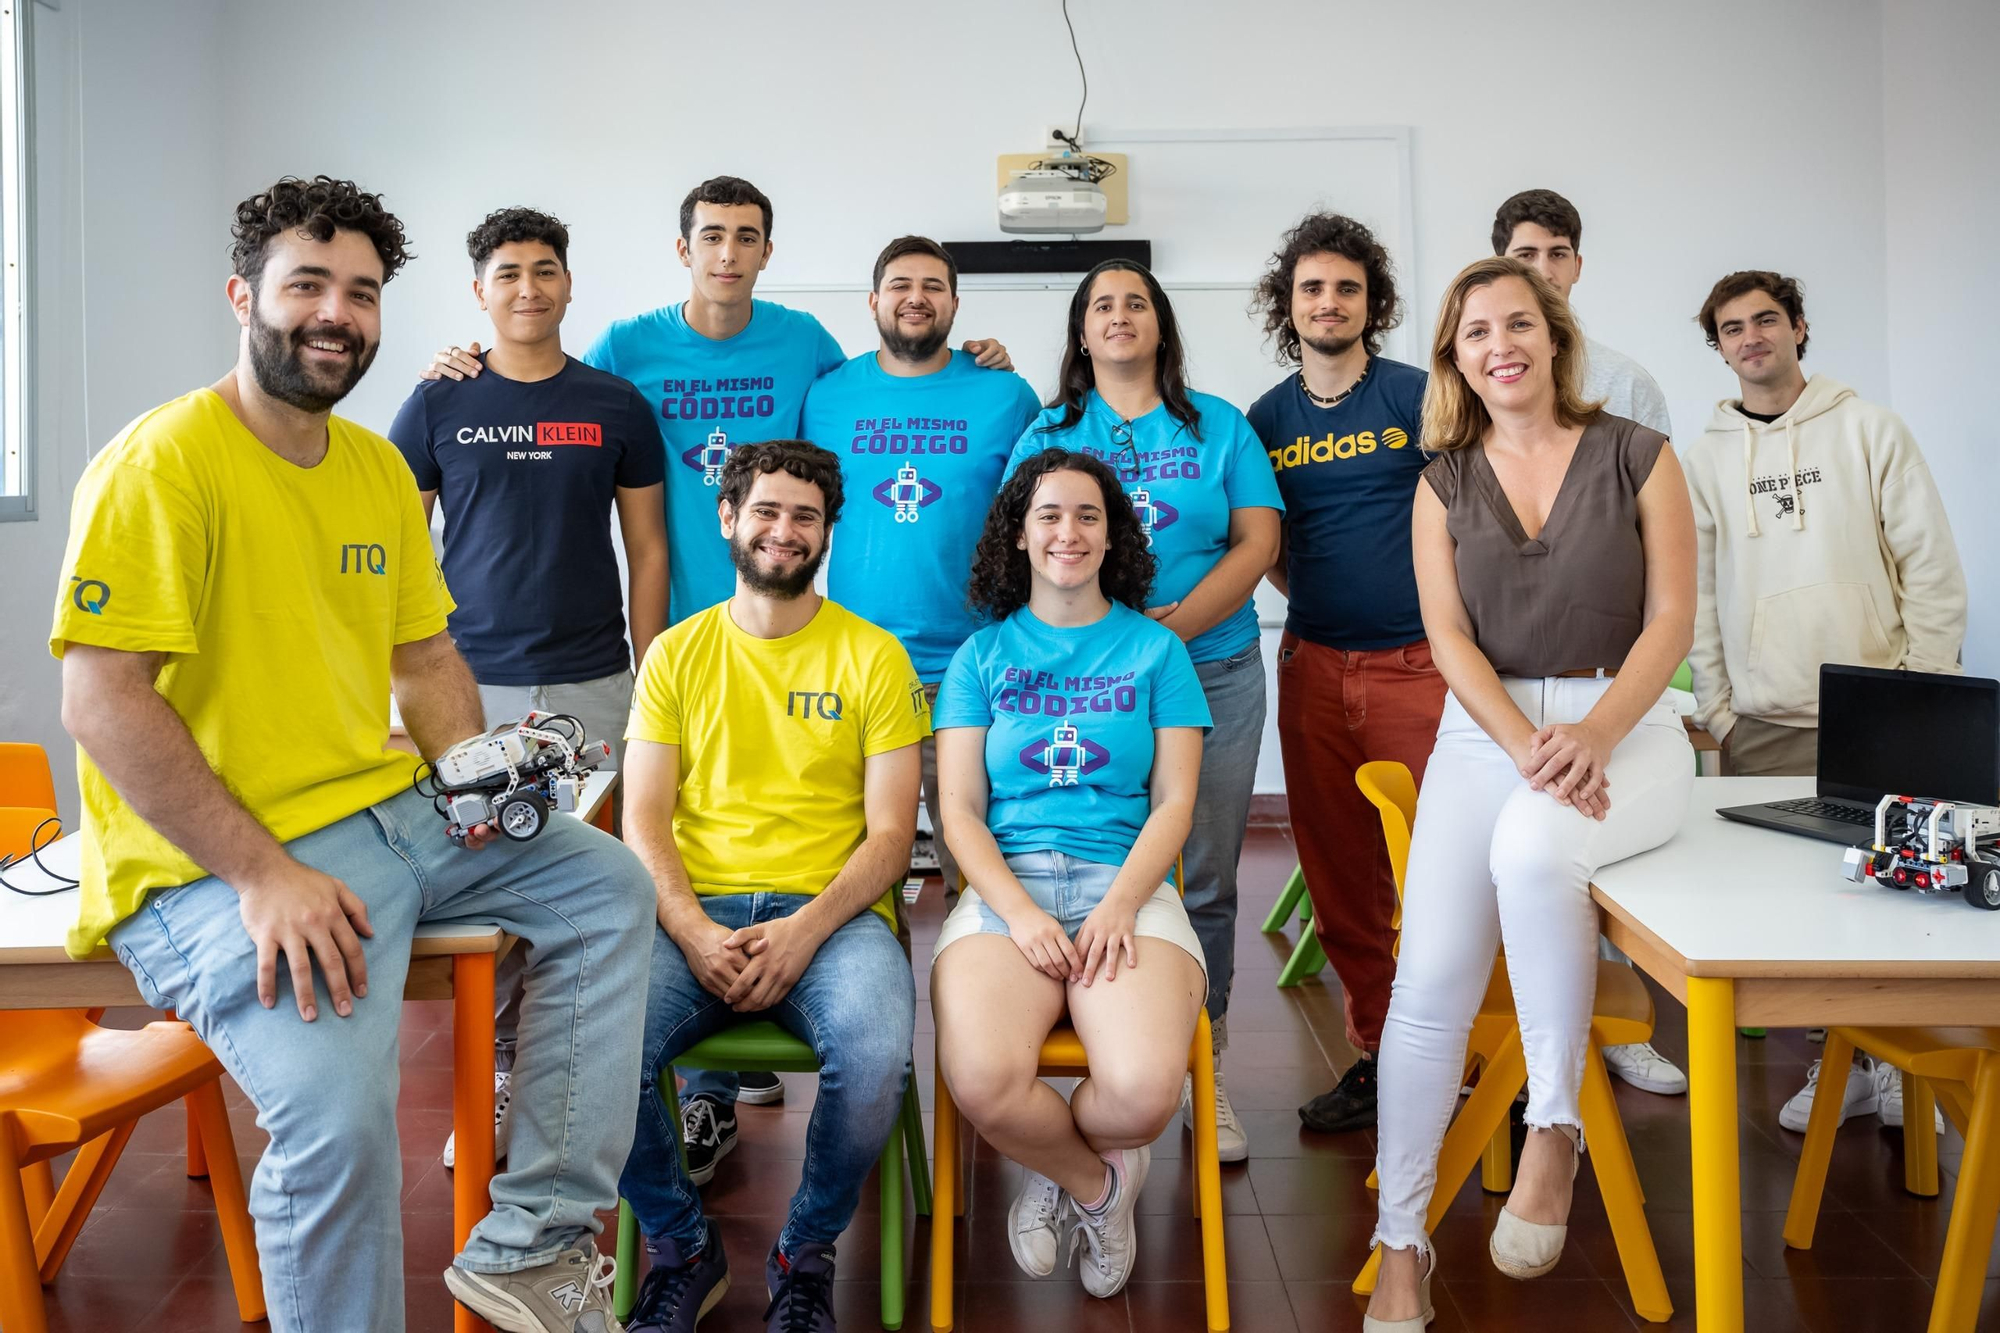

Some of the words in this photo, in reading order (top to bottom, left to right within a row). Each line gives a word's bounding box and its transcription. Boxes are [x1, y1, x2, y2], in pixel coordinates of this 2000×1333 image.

[663, 379, 686, 393] EN
[690, 379, 712, 393] EL
[716, 376, 774, 391] MISMO
[661, 391, 775, 420] CÓDIGO
[456, 425, 533, 444] CALVIN
[543, 426, 597, 442] KLEIN
[855, 418, 877, 432] EN
[881, 417, 902, 430] EL
[907, 417, 968, 431] MISMO
[851, 428, 968, 455] CÓDIGO
[1269, 430, 1378, 472] adidas
[506, 451, 527, 460] NEW
[528, 451, 552, 460] YORK
[1109, 452, 1132, 465] EL
[1136, 446, 1198, 463] MISMO
[1749, 479, 1777, 495] ONE
[1778, 470, 1822, 491] PECE
[340, 543, 386, 575] ITQ
[1005, 667, 1032, 684] EN
[1033, 670, 1058, 690] EL
[1064, 671, 1135, 692] MISMO
[787, 691, 843, 721] ITQ
[998, 684, 1137, 717] CÓDIGO
